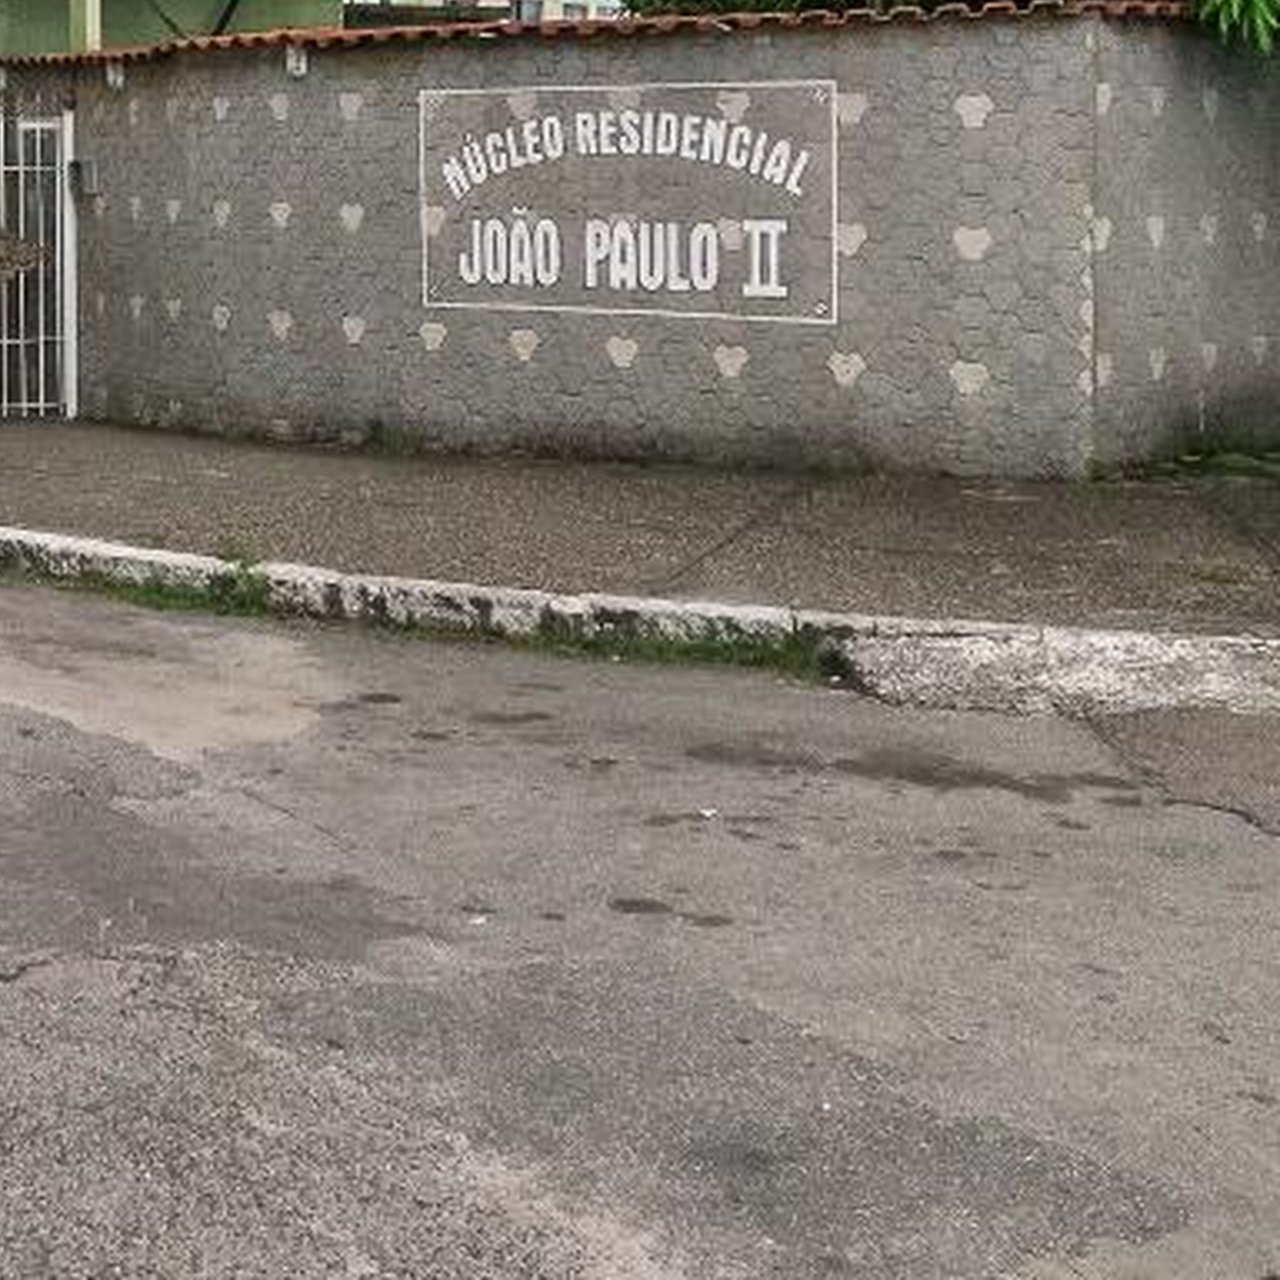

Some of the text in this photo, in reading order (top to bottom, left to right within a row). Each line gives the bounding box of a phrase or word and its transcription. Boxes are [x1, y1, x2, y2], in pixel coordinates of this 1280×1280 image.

[443, 109, 809, 199] NÚCLEO RESIDENCIAL
[460, 206, 787, 297] JOÃO PAULO II
